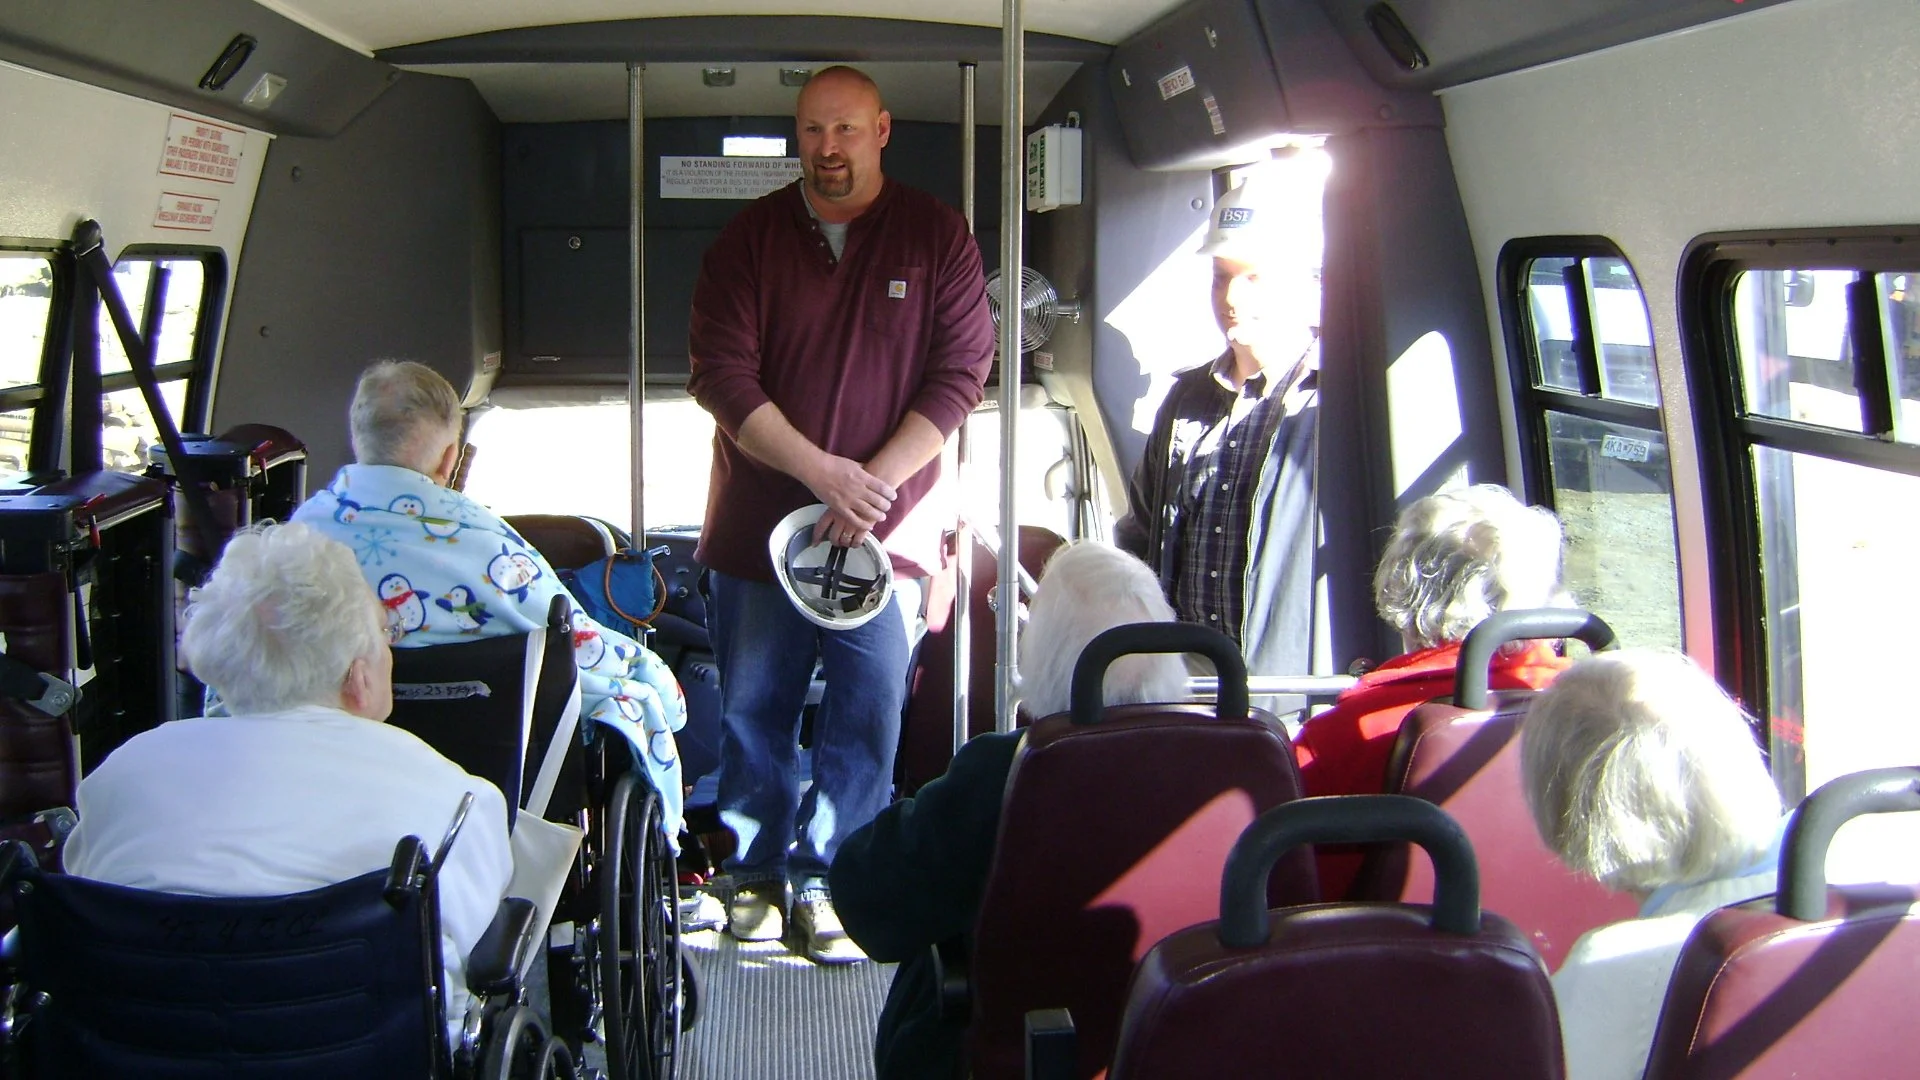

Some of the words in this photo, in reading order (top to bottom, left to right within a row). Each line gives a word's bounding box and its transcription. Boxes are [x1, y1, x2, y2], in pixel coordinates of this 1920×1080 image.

[1178, 72, 1189, 87] EXIT
[681, 160, 692, 168] NO
[694, 160, 731, 168] STANDING
